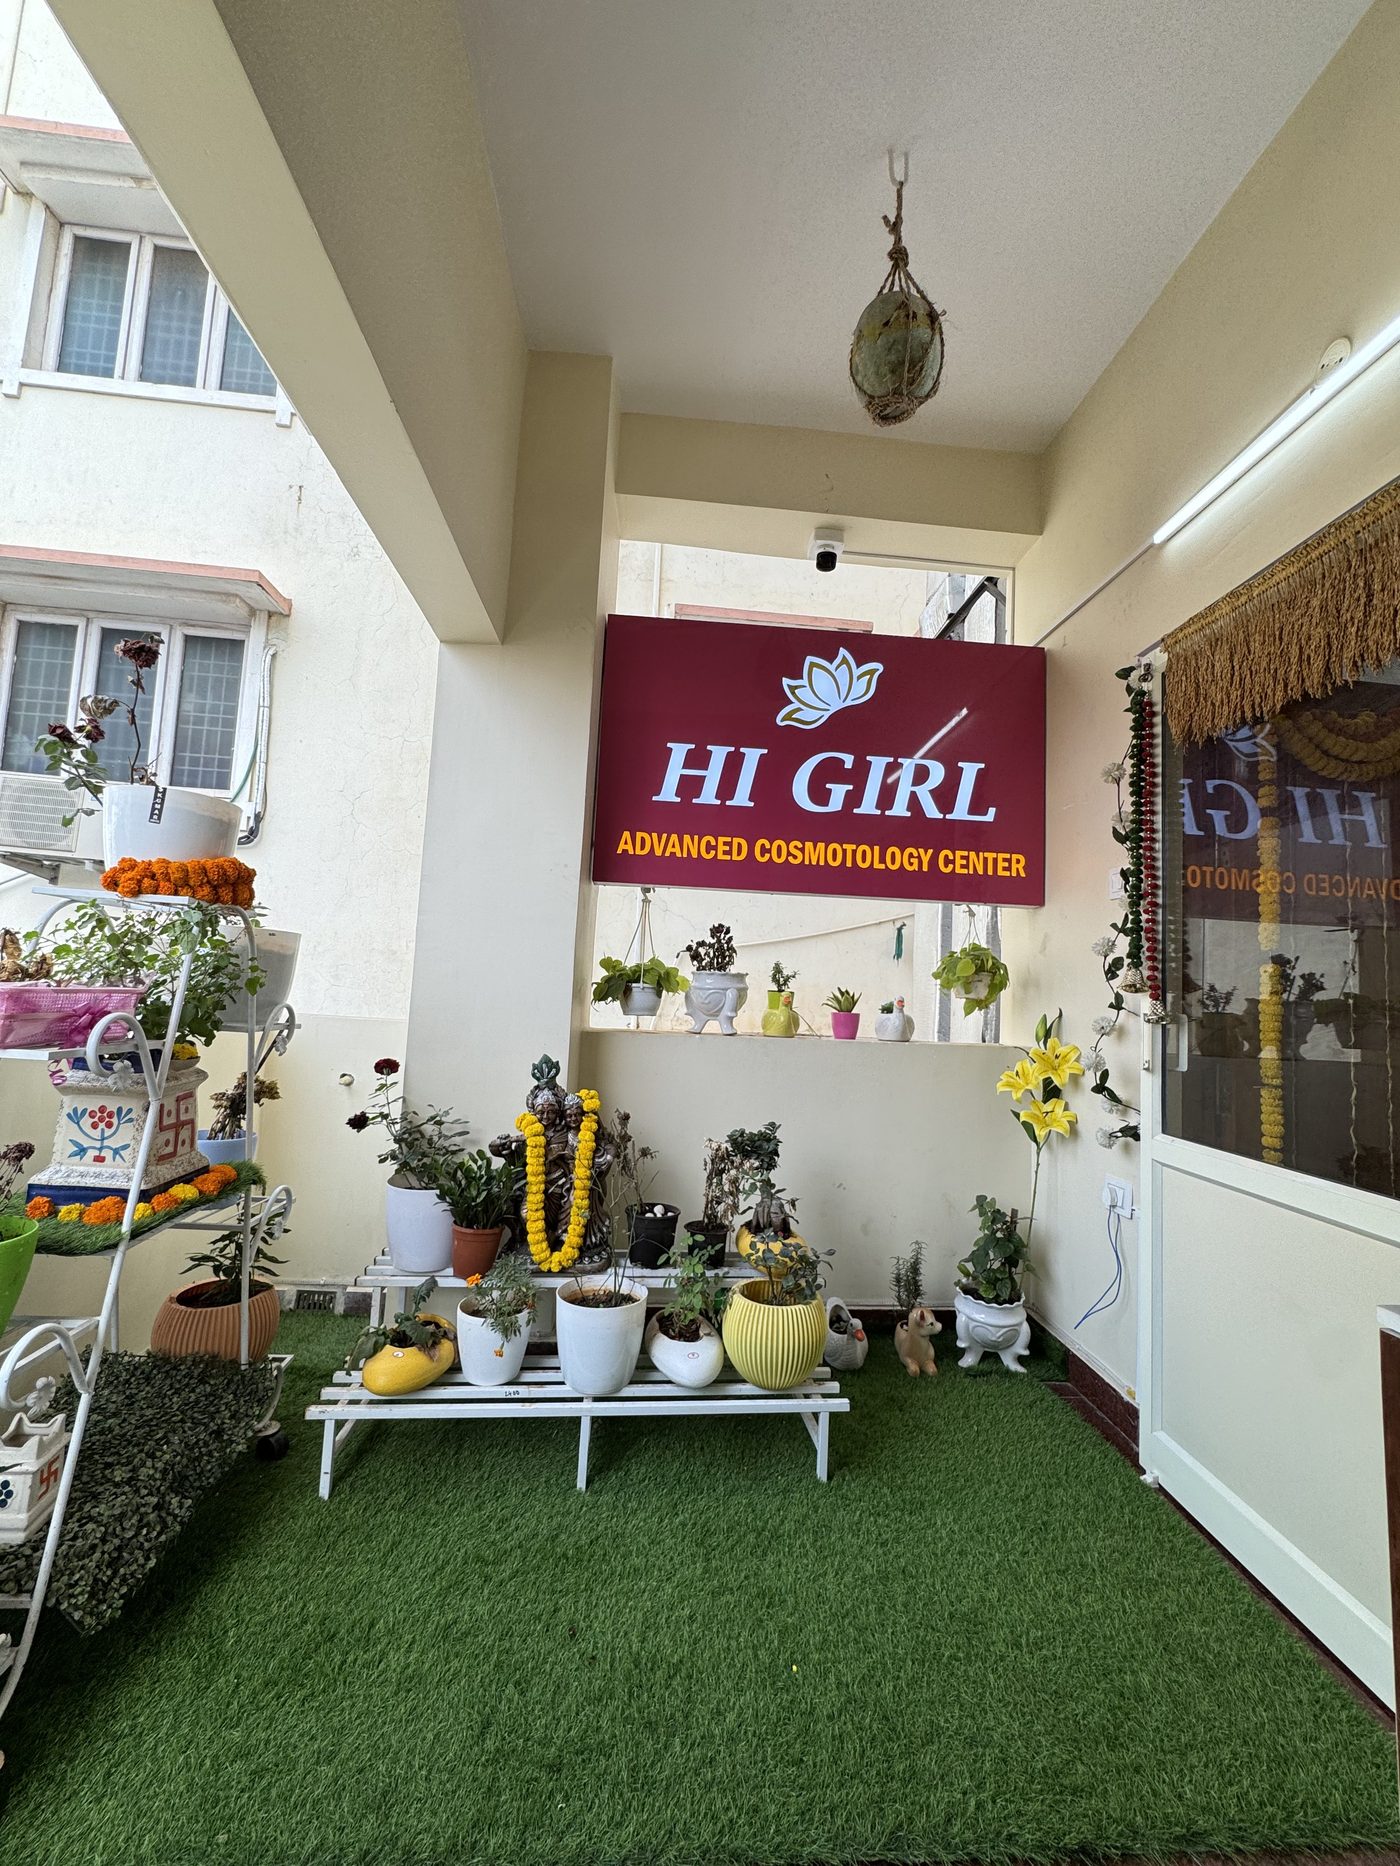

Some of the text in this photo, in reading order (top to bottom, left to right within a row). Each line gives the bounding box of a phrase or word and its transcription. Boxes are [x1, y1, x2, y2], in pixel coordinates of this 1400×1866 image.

[652, 742, 997, 822] HI GIRL
[616, 830, 1026, 878] ADVANCED COSMOTOLOGY CENTER
